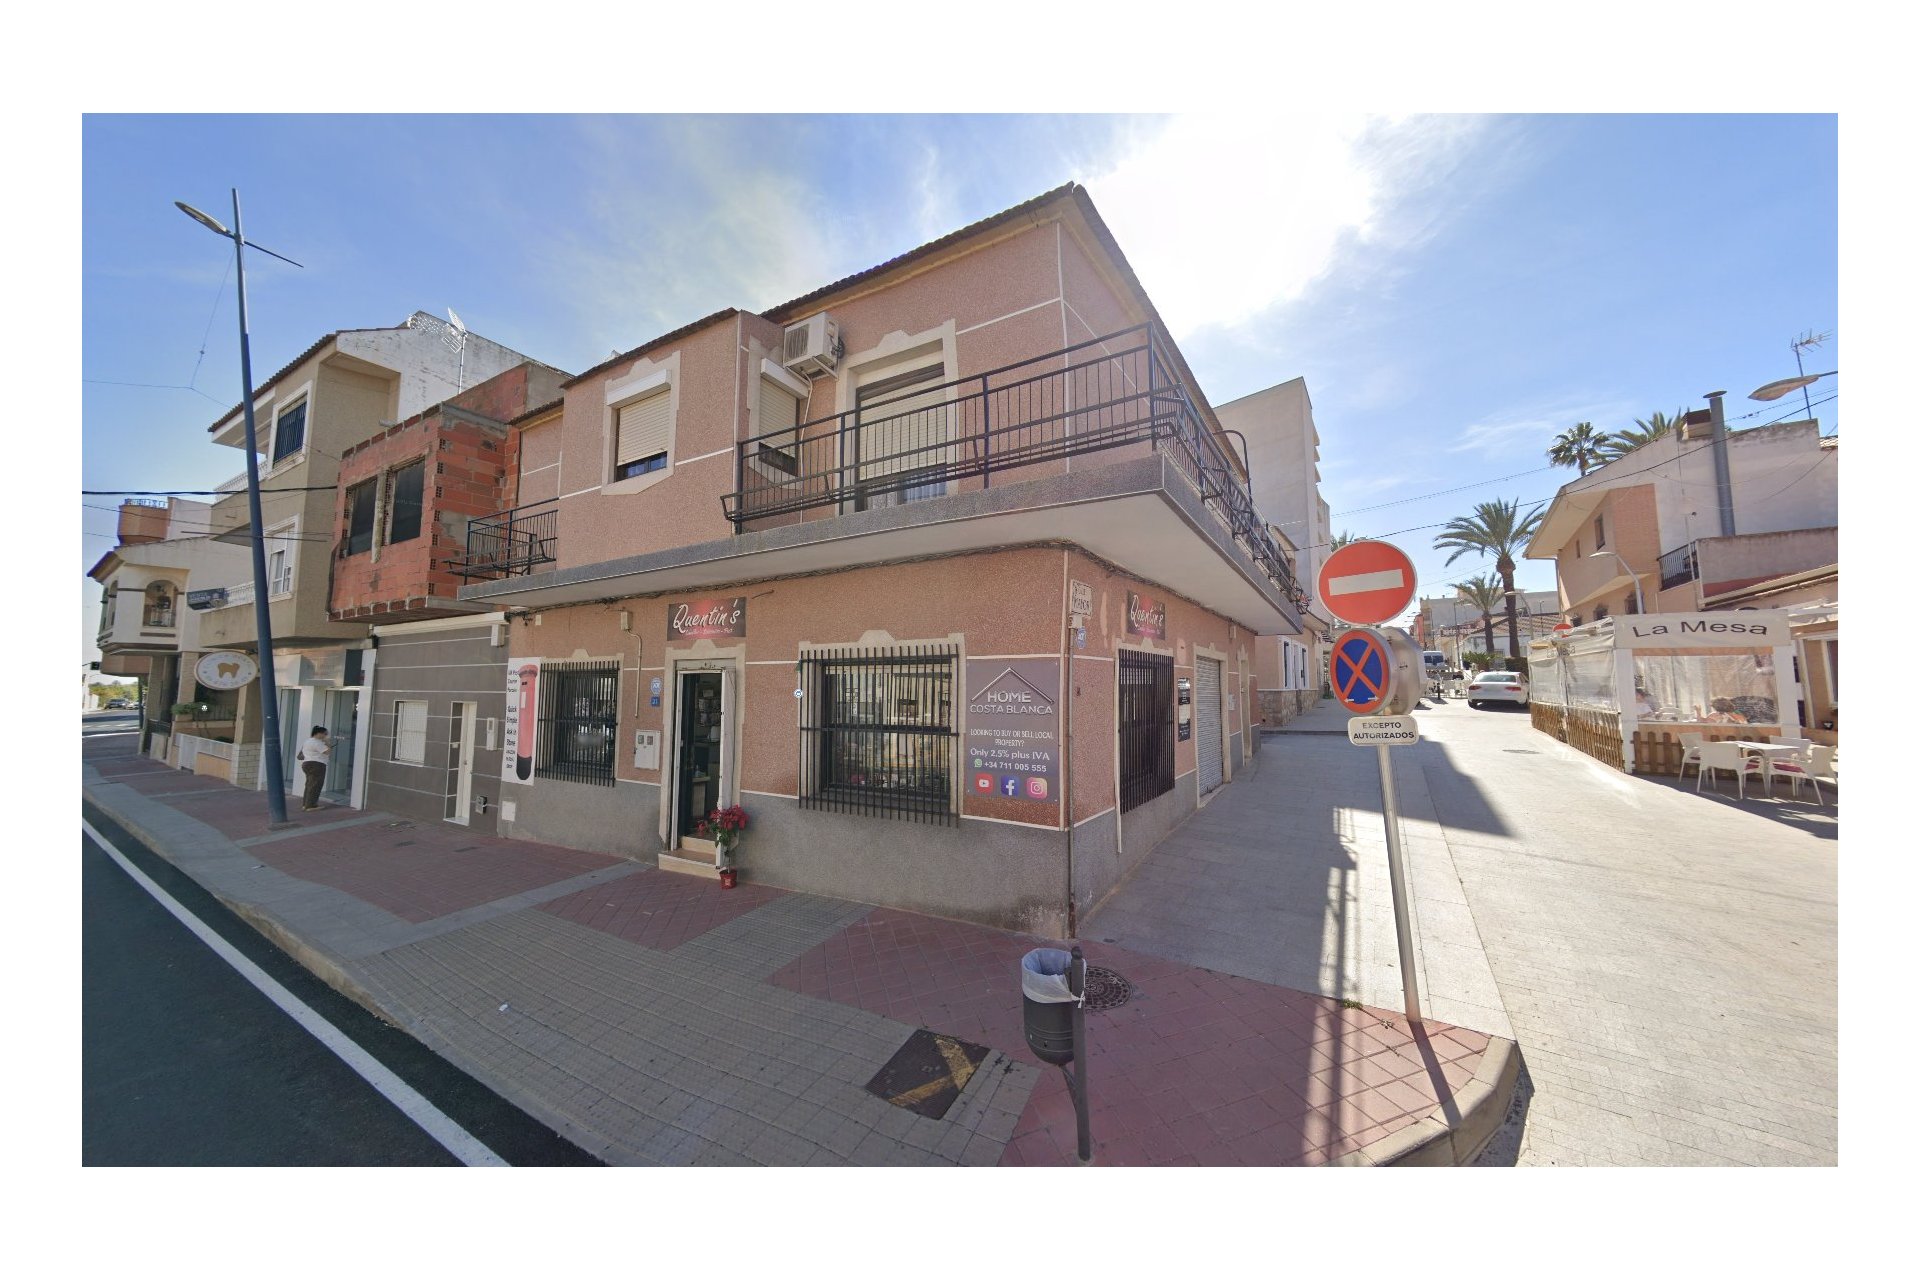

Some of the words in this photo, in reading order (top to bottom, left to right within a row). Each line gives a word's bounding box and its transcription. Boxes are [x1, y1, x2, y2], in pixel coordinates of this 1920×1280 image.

[673, 599, 741, 634] Quentin's
[1632, 624, 1669, 638] La
[1681, 620, 1768, 636] Mesa
[987, 690, 1032, 703] HOME
[969, 704, 1004, 715] COSTA
[1006, 705, 1054, 716] BLANCA
[1362, 721, 1402, 730] EXCEPTO
[970, 728, 993, 737] LOOKING
[993, 729, 1001, 737] TO
[1001, 729, 1012, 737] BUY
[1012, 730, 1021, 738] OR
[1021, 730, 1034, 739] SELL
[1034, 731, 1054, 740] LOCAL
[1353, 731, 1415, 740] AUTORIZADOS
[994, 738, 1025, 748] PROPERTY?
[970, 747, 989, 758] Only
[990, 749, 1010, 758] 2.5%
[1011, 750, 1030, 760] plus
[1032, 751, 1051, 761] IVA
[984, 761, 998, 769] +34
[999, 761, 1012, 770] 711
[1014, 763, 1030, 771] 005
[1031, 764, 1047, 773] 555
